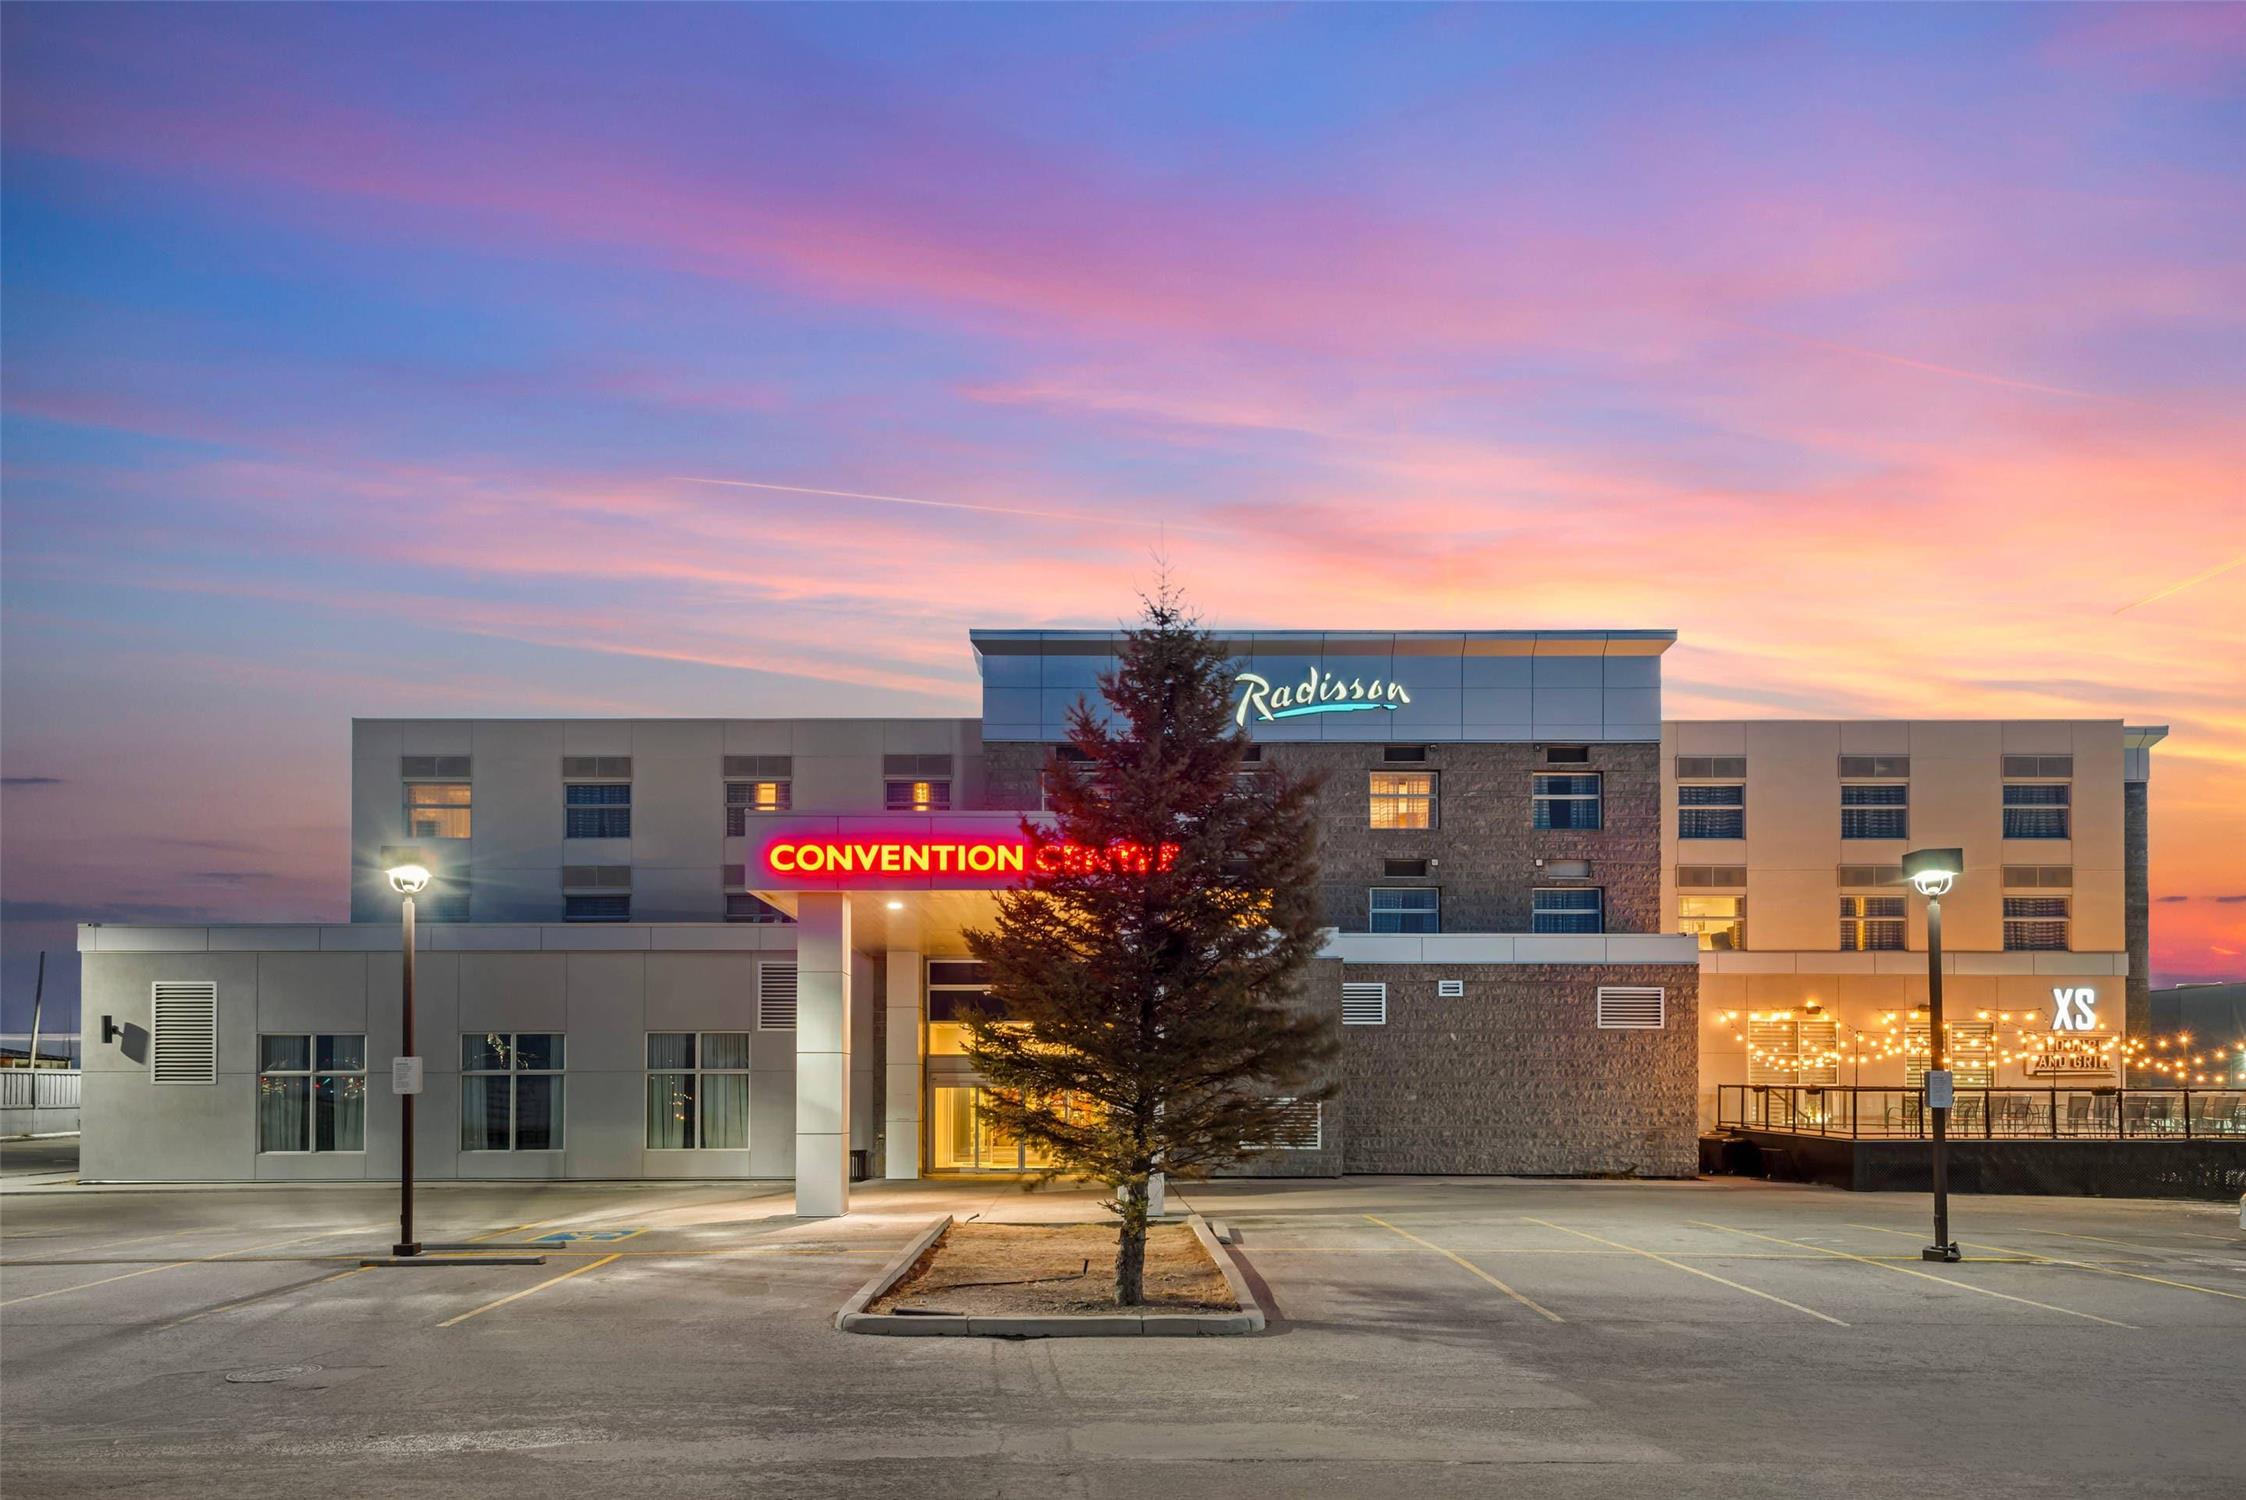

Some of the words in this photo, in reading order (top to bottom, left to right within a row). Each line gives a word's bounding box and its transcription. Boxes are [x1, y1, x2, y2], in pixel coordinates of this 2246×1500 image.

[1234, 666, 1411, 726] Radisson
[770, 844, 1024, 871] CONVENTION
[2053, 988, 2096, 1031] XS
[2039, 1055, 2066, 1067] AND
